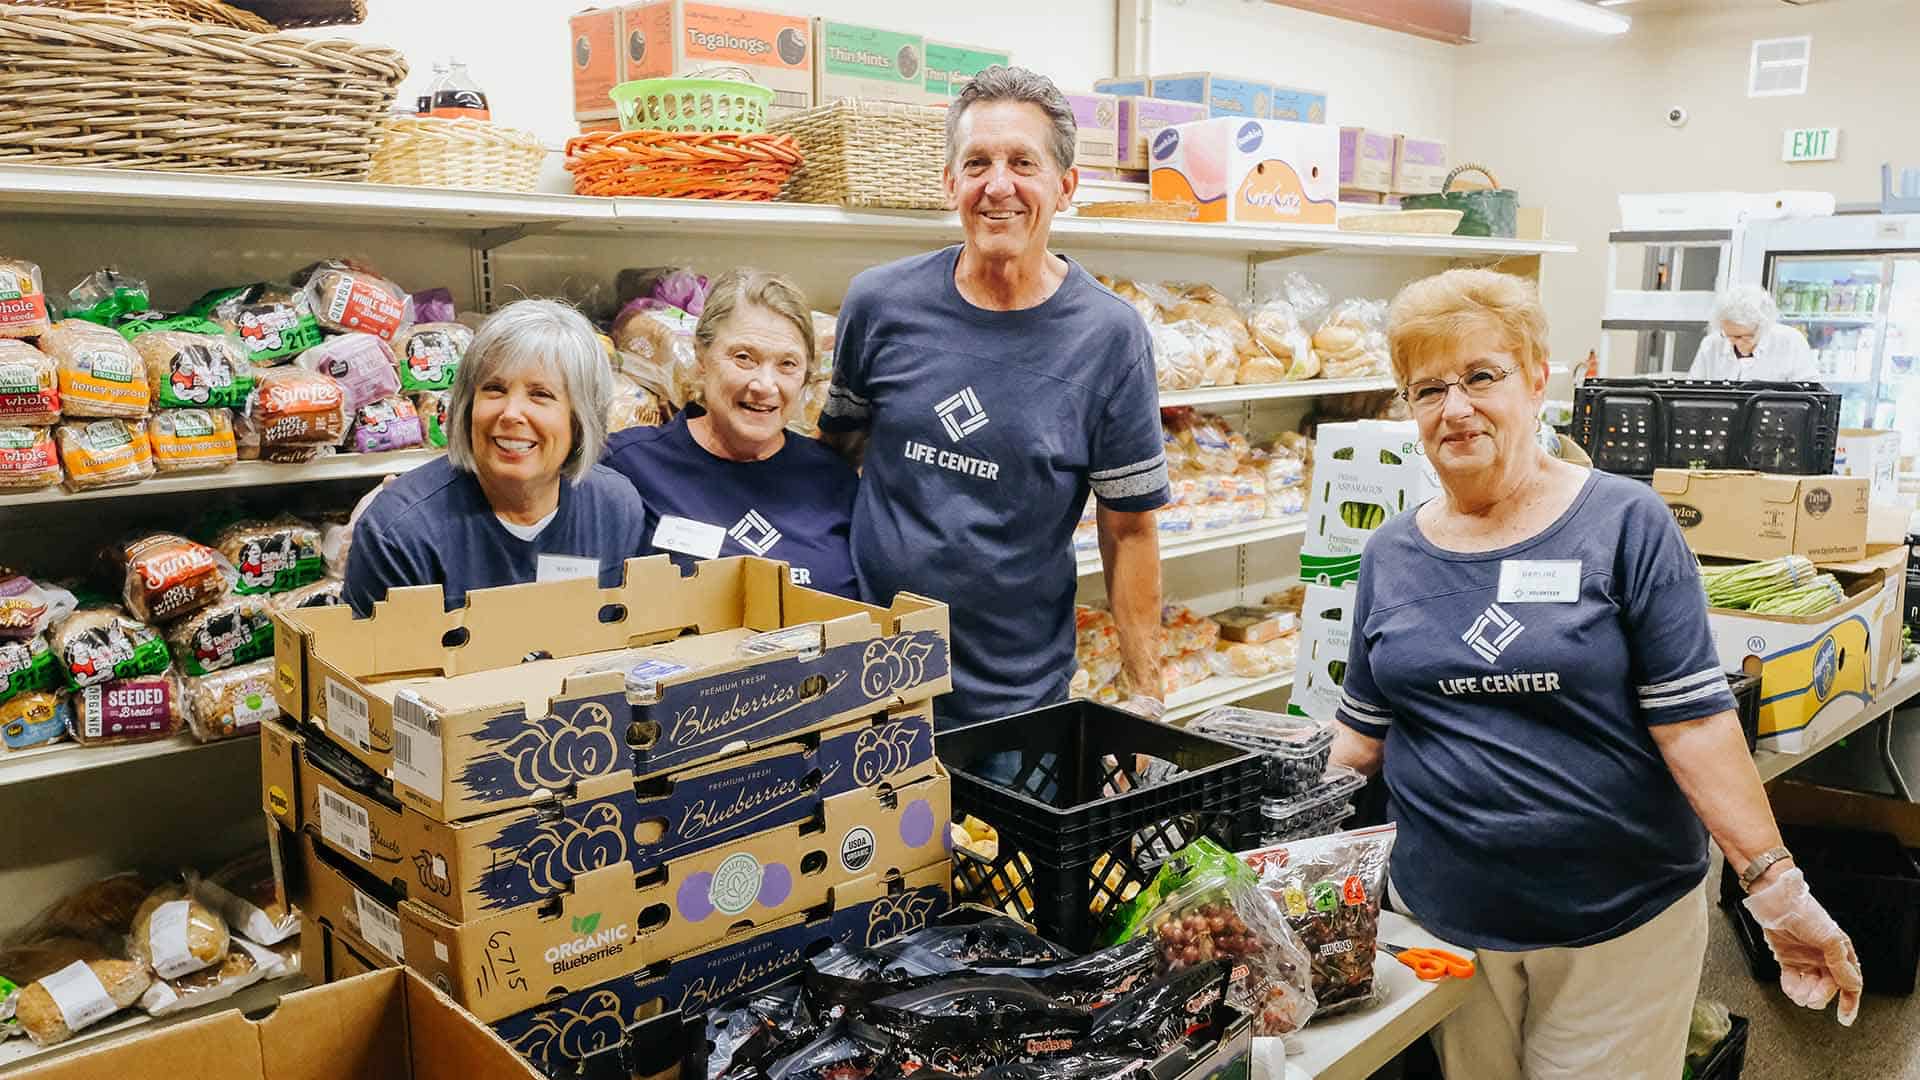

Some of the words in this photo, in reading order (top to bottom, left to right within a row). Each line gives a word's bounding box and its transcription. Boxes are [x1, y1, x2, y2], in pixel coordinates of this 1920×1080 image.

[687, 27, 766, 55] Tagalongs
[830, 47, 854, 61] Thin
[855, 51, 890, 67] Mints
[1792, 130, 1830, 158] EXIT
[0, 300, 34, 313] hole
[286, 331, 306, 350] 21
[0, 386, 38, 394] RGANIC
[71, 381, 107, 395] honey
[270, 385, 310, 410] Sara
[5, 395, 50, 406] whole
[214, 391, 233, 406] 21
[265, 421, 309, 434] WHOLE
[265, 430, 306, 441] WHEAT
[4, 449, 48, 462] whole
[904, 440, 937, 464] LIFE
[937, 450, 1000, 480] CENTER
[1671, 506, 1698, 519] aylor
[145, 552, 188, 590] Sara
[700, 681, 738, 697] PREMIUM
[741, 673, 767, 686] FRESH
[1438, 677, 1481, 695] LIFE
[1481, 671, 1561, 693] CENTER
[108, 688, 164, 707] SEEDED
[118, 706, 154, 718] Bread
[670, 683, 795, 746] Blueberries
[708, 776, 745, 792] PREMIUM
[748, 767, 771, 780] FRESH
[677, 778, 796, 840] Blueberries
[848, 837, 867, 850] USDA
[847, 848, 869, 861] ORGANIC
[544, 923, 629, 964] ORGANIC
[551, 943, 624, 976] Blueberries
[706, 950, 746, 969] PREMIUM
[680, 948, 801, 1017] Blueberries
